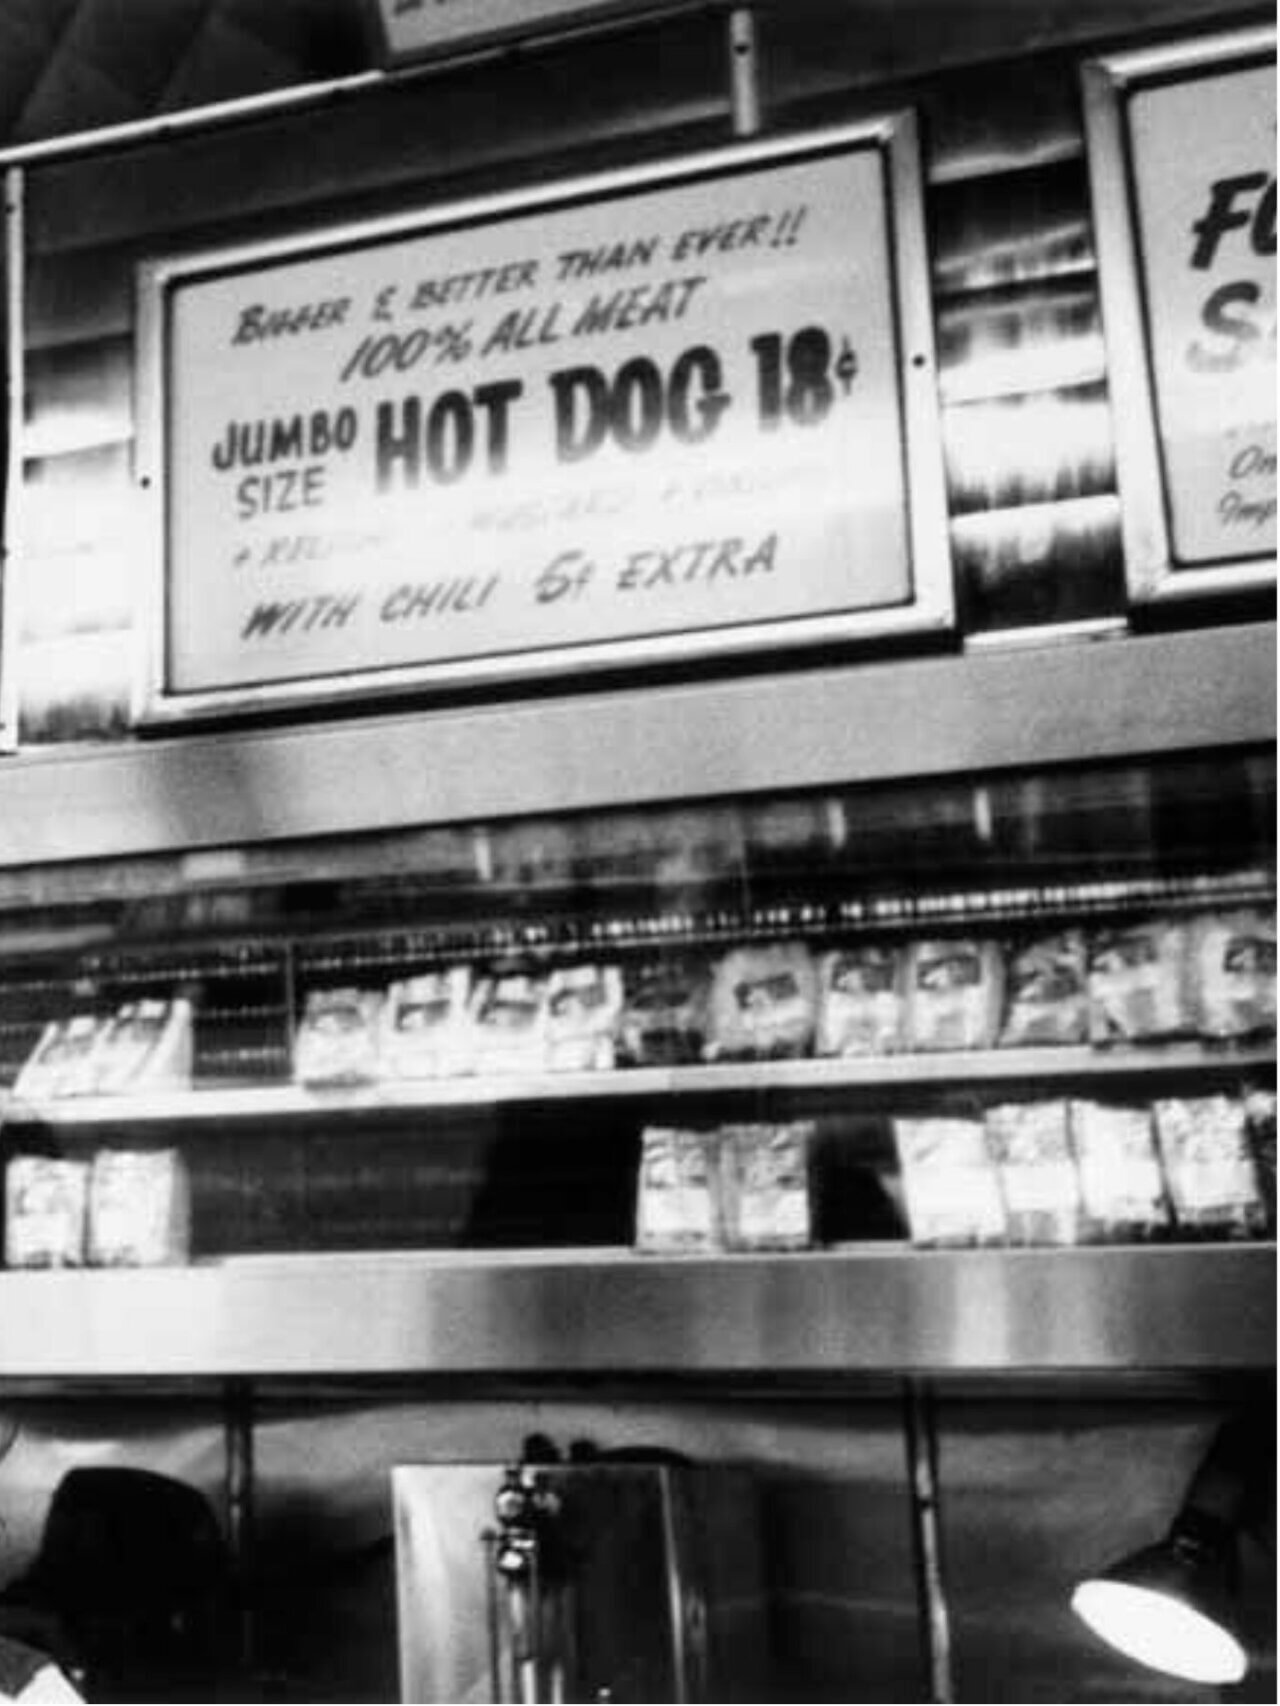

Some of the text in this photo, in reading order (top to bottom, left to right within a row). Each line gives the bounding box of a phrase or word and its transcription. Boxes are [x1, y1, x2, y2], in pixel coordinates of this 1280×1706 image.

[231, 298, 352, 346] BIGGER
[409, 261, 540, 312] BETTER
[557, 236, 660, 281] THAN
[671, 205, 807, 263] EVER!!
[340, 276, 707, 383] 100% ALL MEAT
[211, 406, 357, 472] JUMBO
[373, 378, 523, 496] HOT
[549, 344, 732, 466] DOG
[236, 465, 326, 521] SIZE
[241, 595, 357, 642] WITH
[379, 575, 500, 625] CHILI
[616, 533, 780, 592] EXTRA
